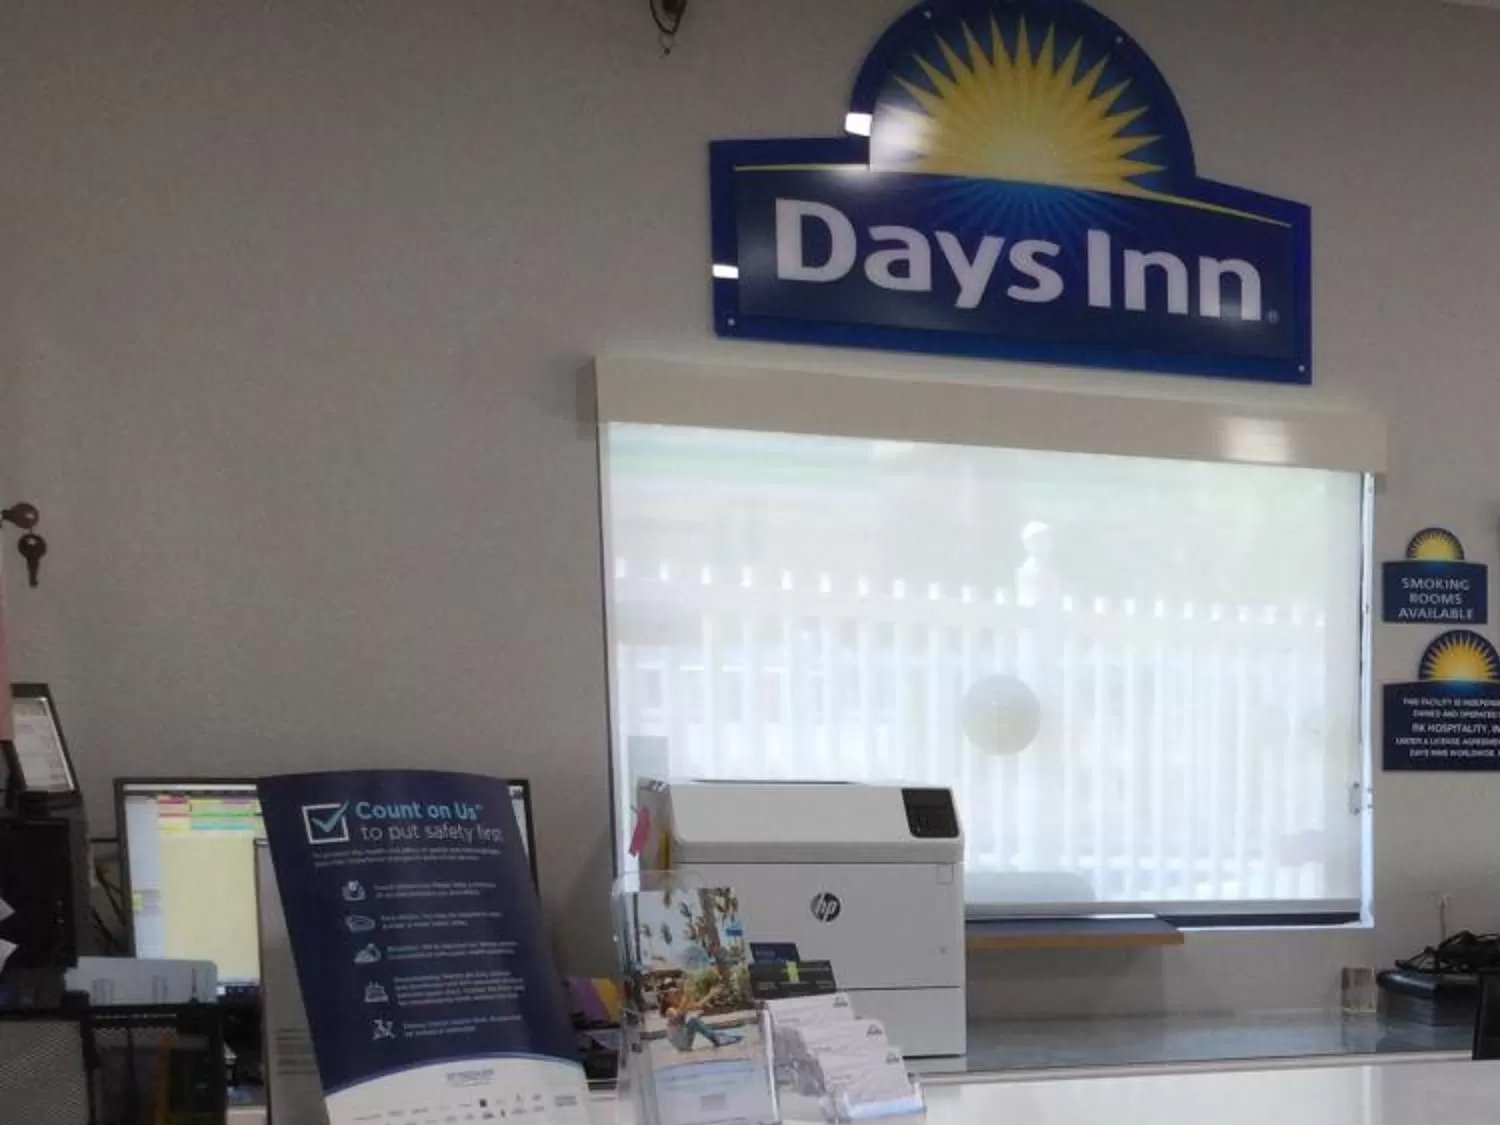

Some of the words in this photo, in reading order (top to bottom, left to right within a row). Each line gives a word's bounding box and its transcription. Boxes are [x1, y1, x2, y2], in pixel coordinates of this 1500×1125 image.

[775, 197, 1065, 310] Days
[1087, 229, 1262, 322] Inn
[1401, 577, 1471, 590] SMOKING
[1409, 592, 1463, 605] ROOMS
[1398, 607, 1473, 621] AVAILABLE
[355, 801, 422, 820] Count
[427, 804, 452, 819] on
[360, 826, 384, 842] to
[388, 824, 420, 844] put
[424, 823, 474, 843] safety
[811, 891, 842, 923] hp
